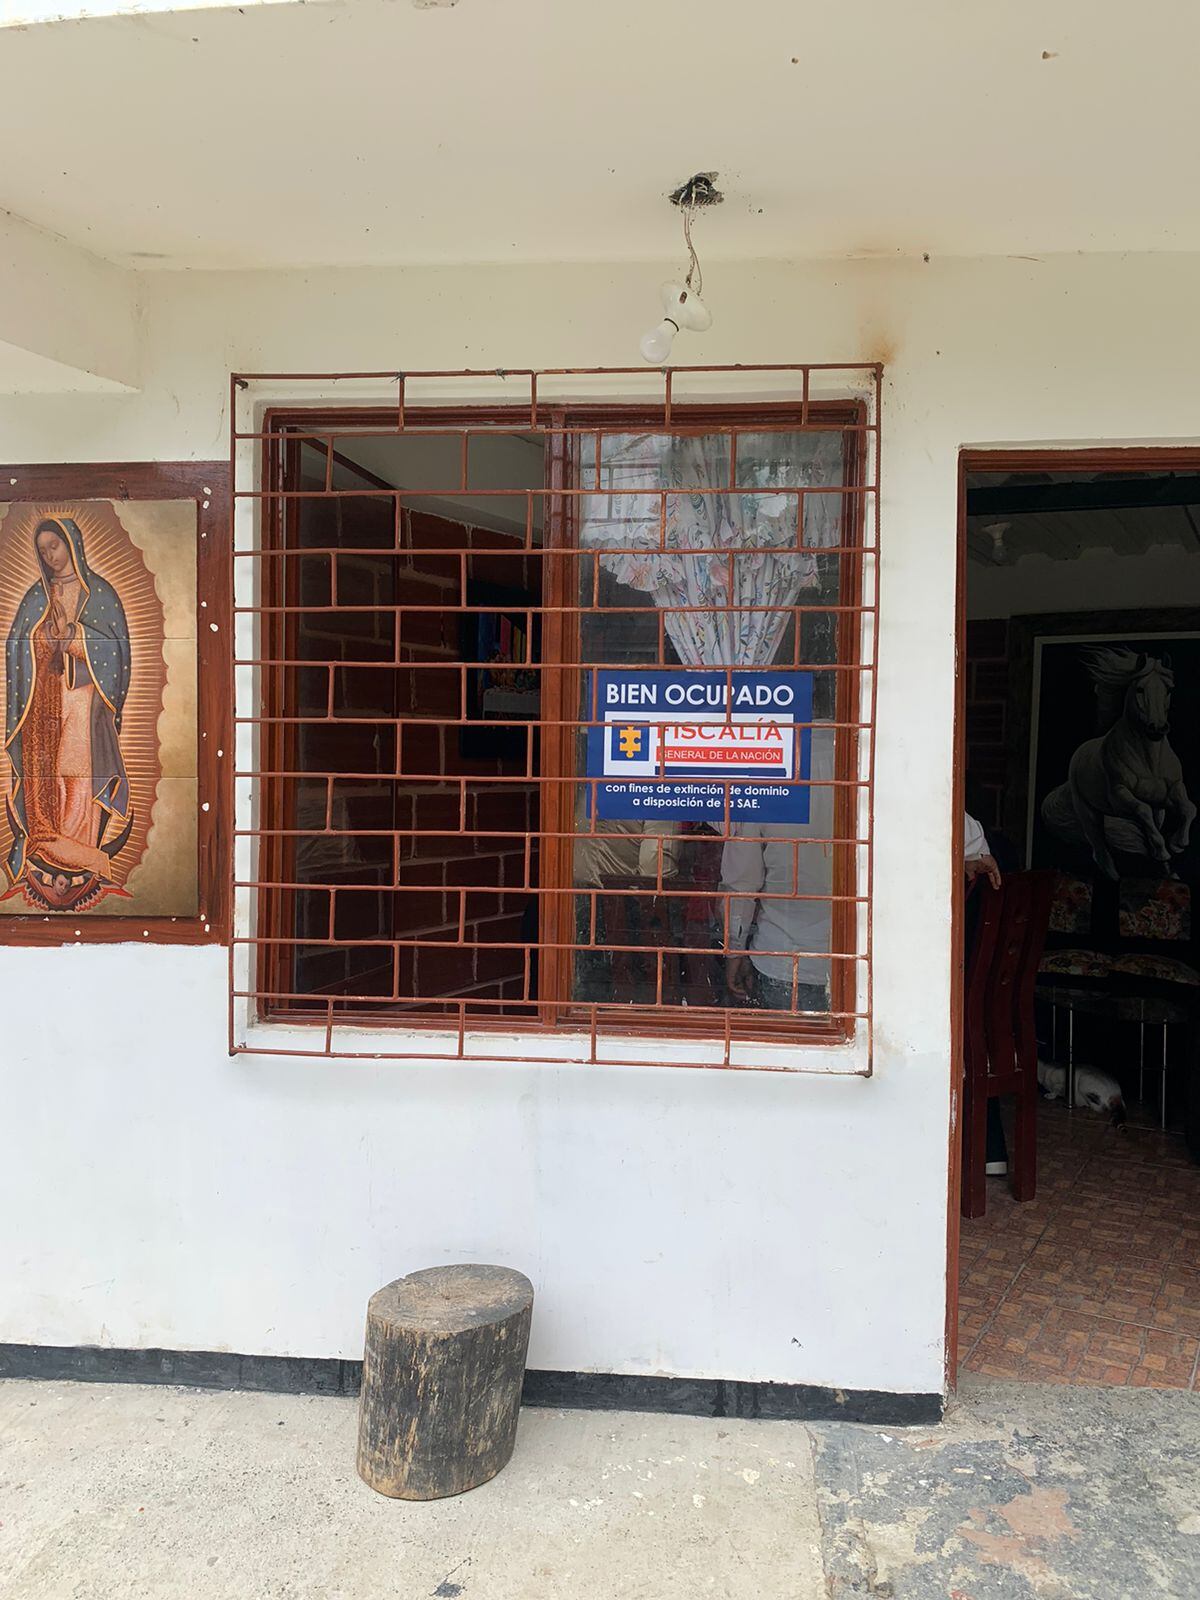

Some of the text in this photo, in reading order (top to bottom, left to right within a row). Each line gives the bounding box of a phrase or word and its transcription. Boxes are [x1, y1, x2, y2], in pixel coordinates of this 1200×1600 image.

[607, 684, 794, 706] BIEN OCUPADO
[710, 750, 721, 761] DE
[726, 750, 739, 761] LA
[741, 749, 780, 761] NACIÓN
[605, 785, 626, 793] con
[629, 783, 654, 794] fines
[656, 783, 670, 794] de
[674, 783, 724, 795] extinción
[744, 785, 790, 796] dominio
[633, 798, 640, 807] a
[643, 796, 704, 809] disposición
[706, 798, 721, 808] de
[737, 798, 761, 809] SAE.
